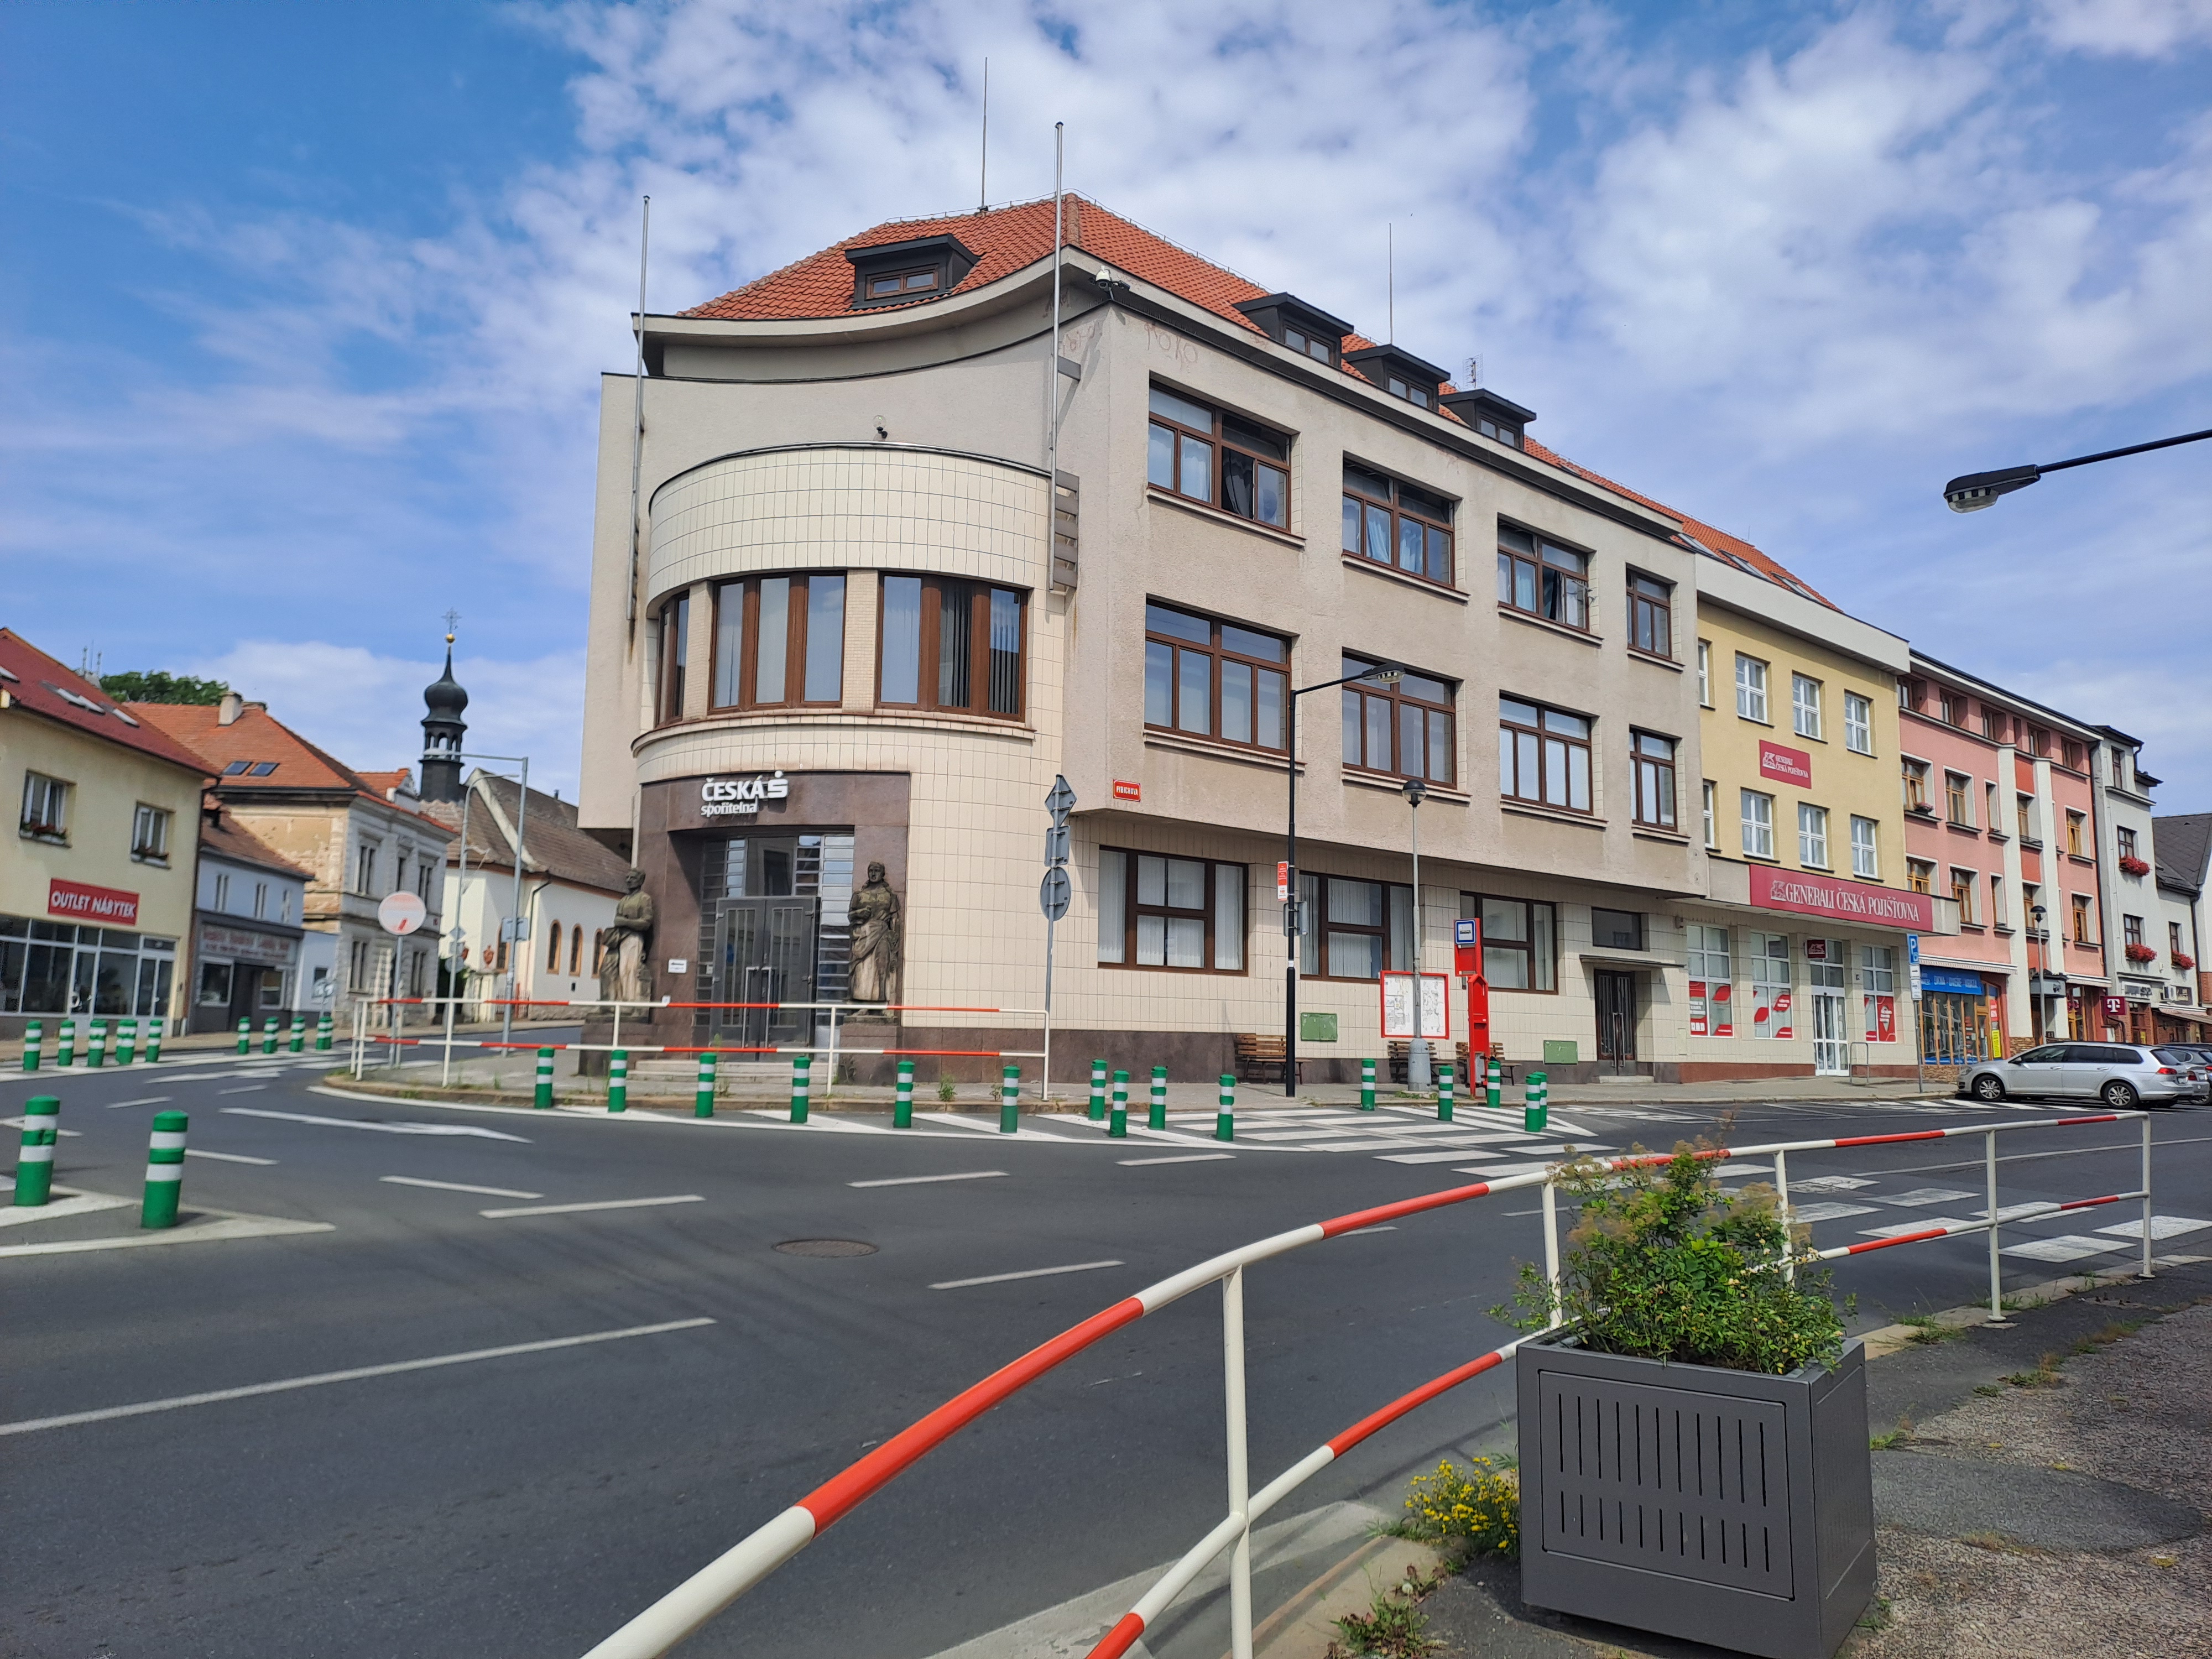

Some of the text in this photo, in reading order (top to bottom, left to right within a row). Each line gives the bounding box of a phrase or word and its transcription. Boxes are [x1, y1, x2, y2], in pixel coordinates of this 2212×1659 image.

[702, 775, 765, 801] ČESKÁ
[1117, 786, 1138, 795] FIBICHOVA
[701, 801, 758, 818] spořitelna
[51, 890, 135, 918] OUTLET NÁBYTEK
[1785, 883, 1920, 922] GENERALI ČESKÁ POJIŠŤOVNA
[1910, 938, 1917, 955] P
[2107, 999, 2121, 1013] T
